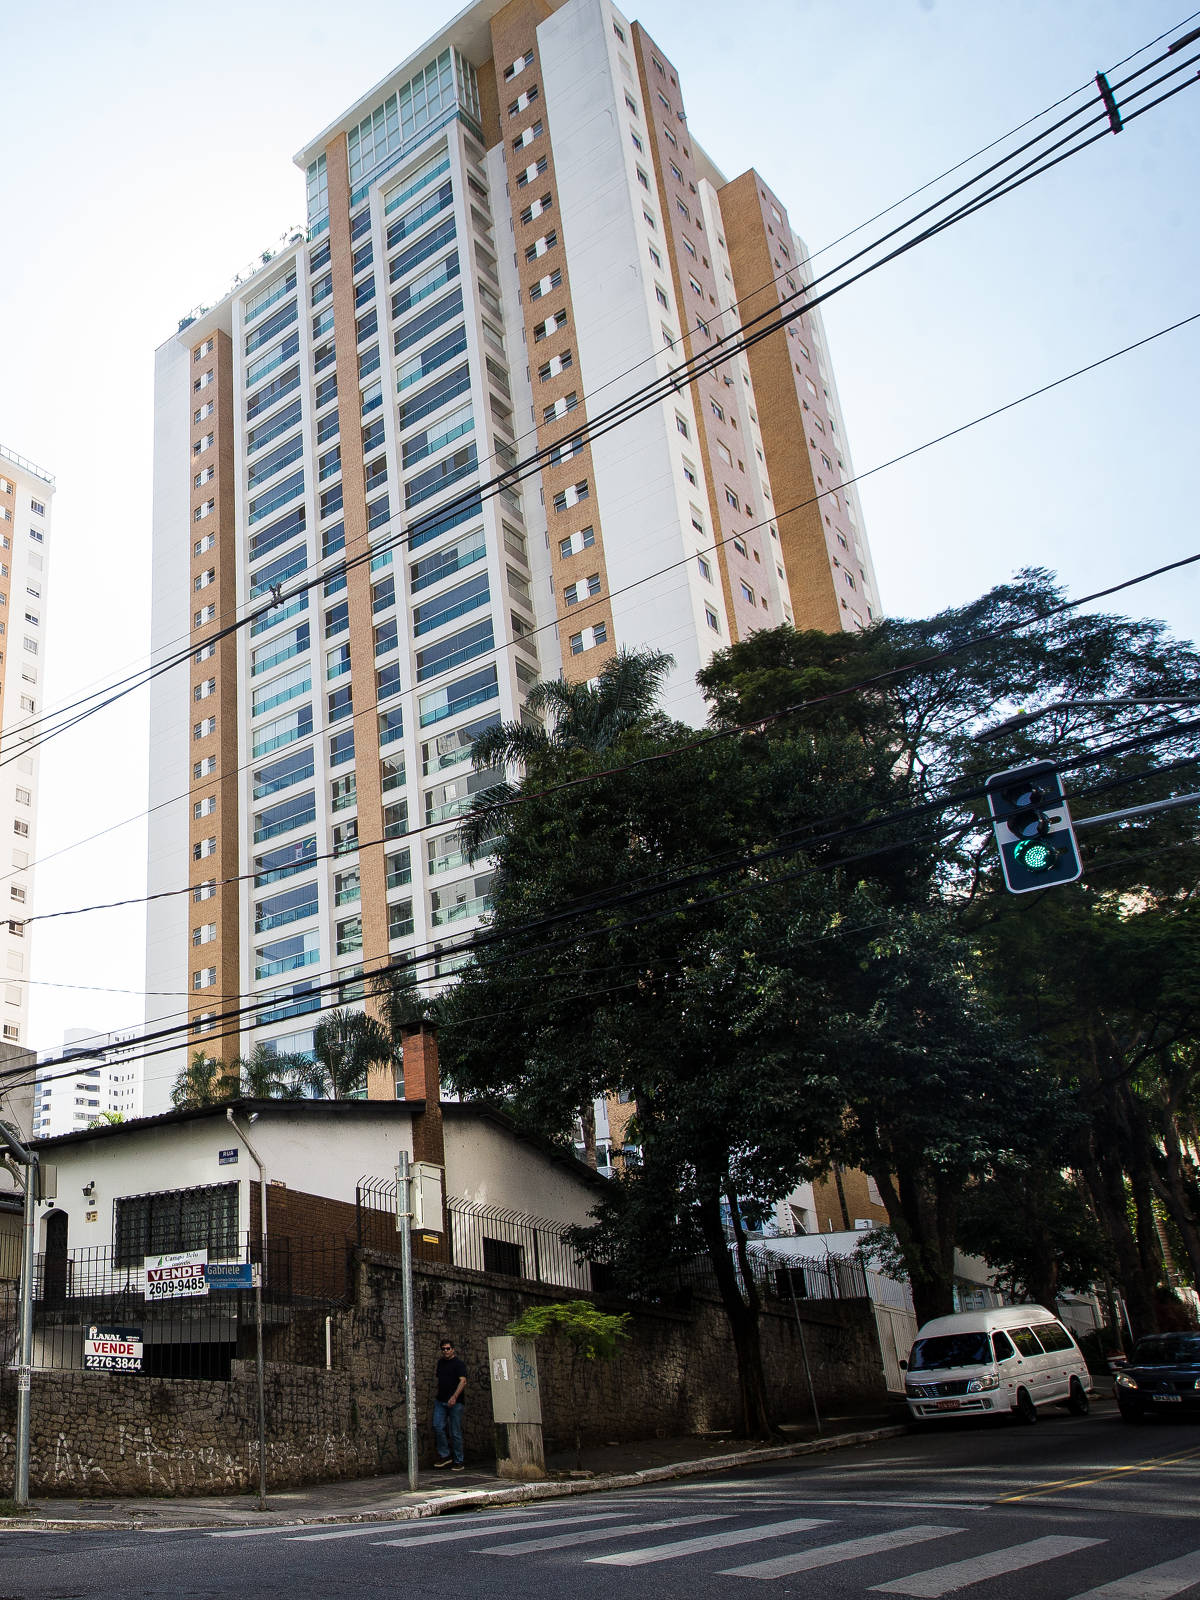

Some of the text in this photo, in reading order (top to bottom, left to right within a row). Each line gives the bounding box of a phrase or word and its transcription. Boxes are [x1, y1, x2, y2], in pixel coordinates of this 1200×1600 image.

[151, 1265, 202, 1281] VENDE
[207, 1265, 240, 1275] Gabriele
[149, 1277, 205, 1295] 2609-9485
[89, 1325, 121, 1341] PLANAL
[93, 1342, 134, 1354] VENDE
[86, 1356, 141, 1370] 2276-3844
